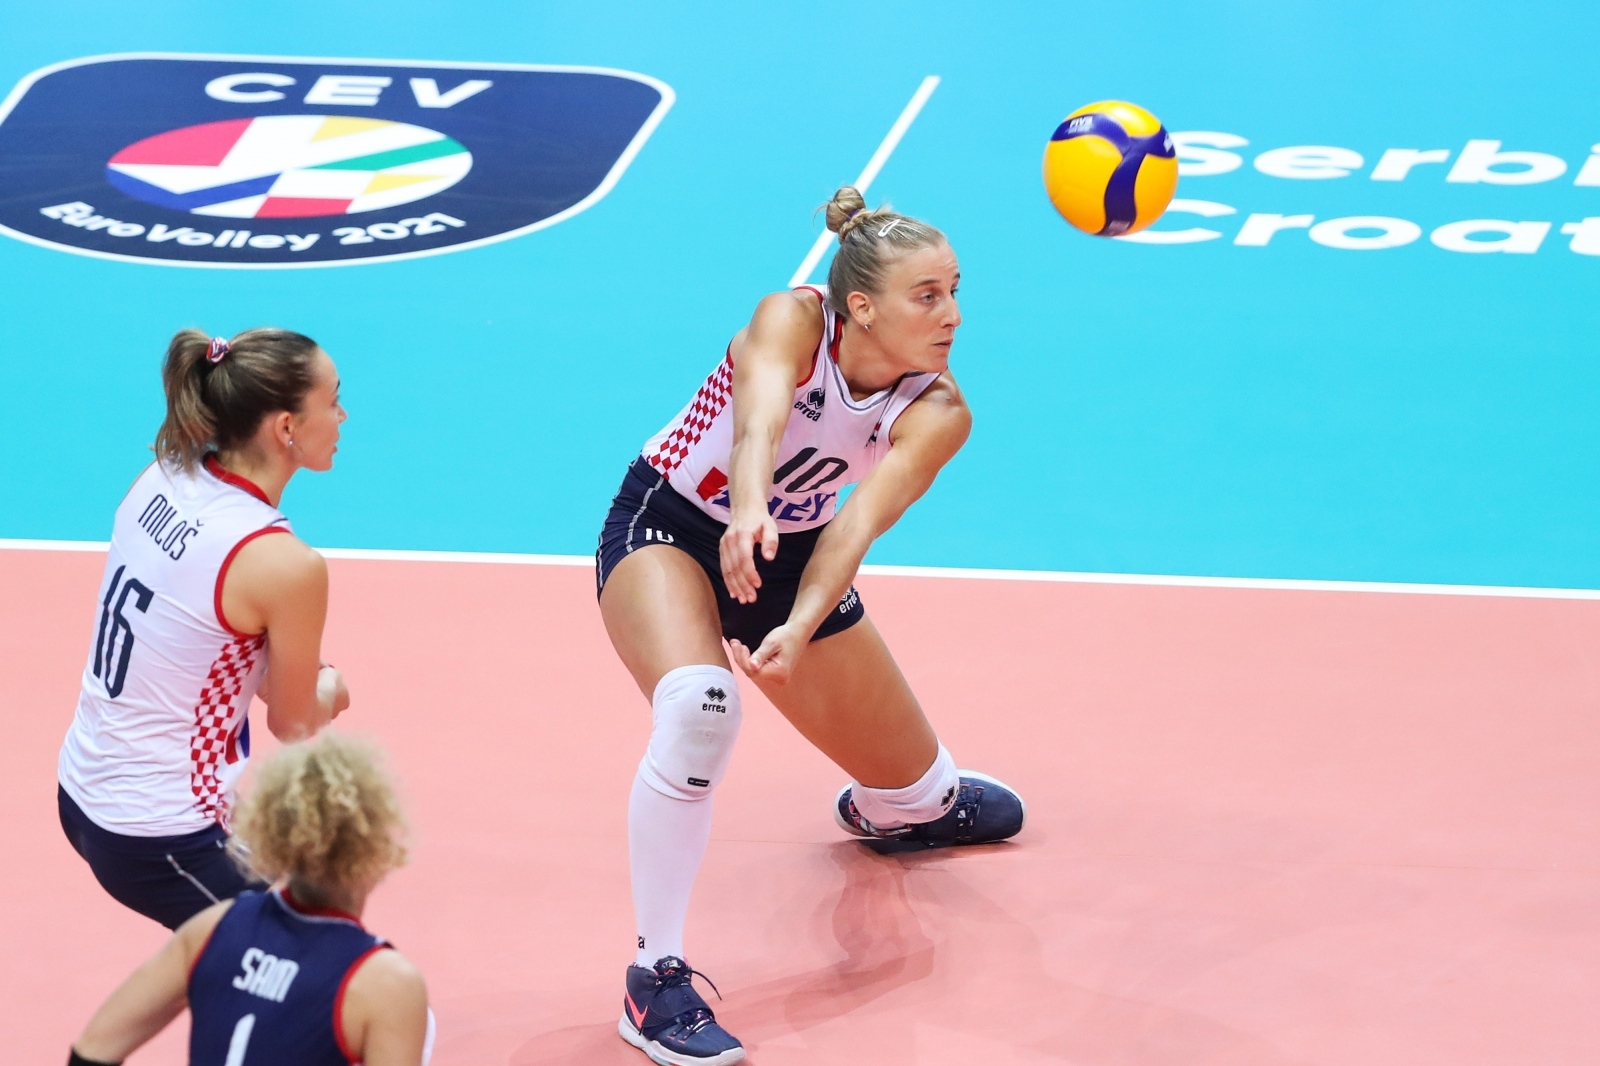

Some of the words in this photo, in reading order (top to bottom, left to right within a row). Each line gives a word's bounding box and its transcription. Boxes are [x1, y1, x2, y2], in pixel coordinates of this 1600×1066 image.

[205, 72, 494, 109] CEV
[39, 201, 321, 252] EuroVolley
[332, 212, 467, 245] 2021
[773, 447, 849, 494] 10
[137, 494, 204, 561] MILOŠ
[93, 565, 155, 699] 16
[231, 947, 300, 1003] SAM
